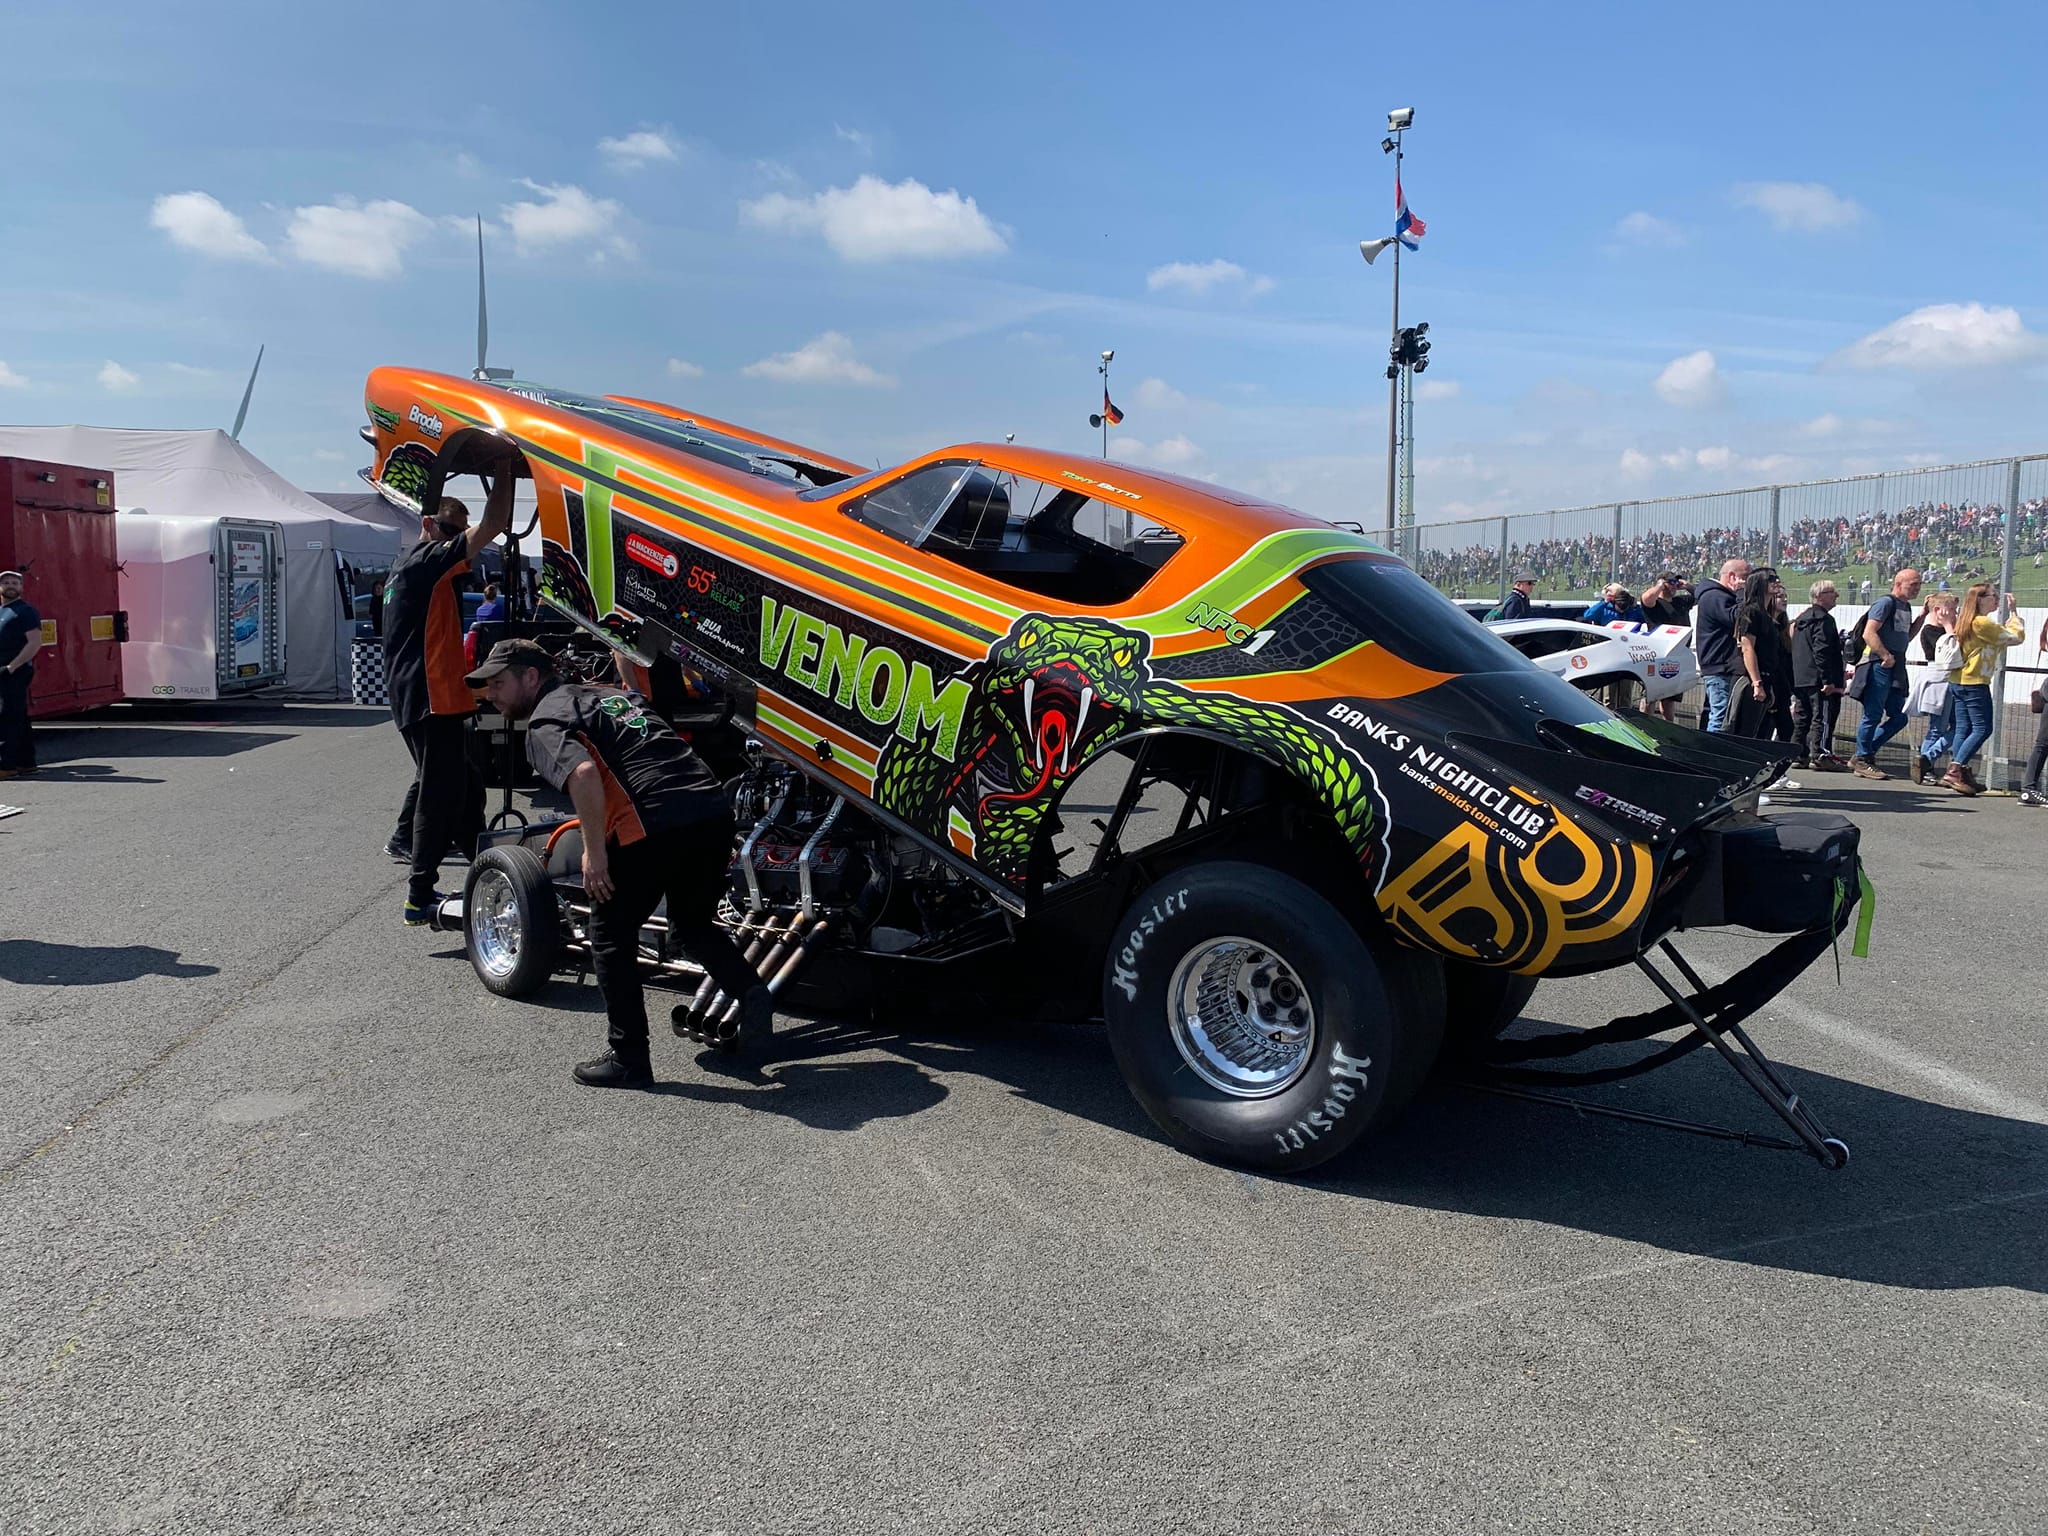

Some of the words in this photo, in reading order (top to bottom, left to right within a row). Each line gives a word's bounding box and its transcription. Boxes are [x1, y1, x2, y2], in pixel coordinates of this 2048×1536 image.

[409, 403, 443, 433] Brodie
[656, 601, 668, 610] LTD
[710, 589, 741, 613] RELEASE
[696, 621, 745, 655] Motorsport
[702, 617, 722, 634] BUA
[1628, 650, 1657, 665] WARP
[759, 594, 974, 764] VENOM
[1326, 702, 1411, 752] BANKS
[1398, 762, 1528, 850] banksmaidstone.com
[1408, 744, 1546, 836] NIGHTCLUB
[1575, 784, 1667, 826] EXTREME
[1112, 887, 1190, 1003] Hoosier
